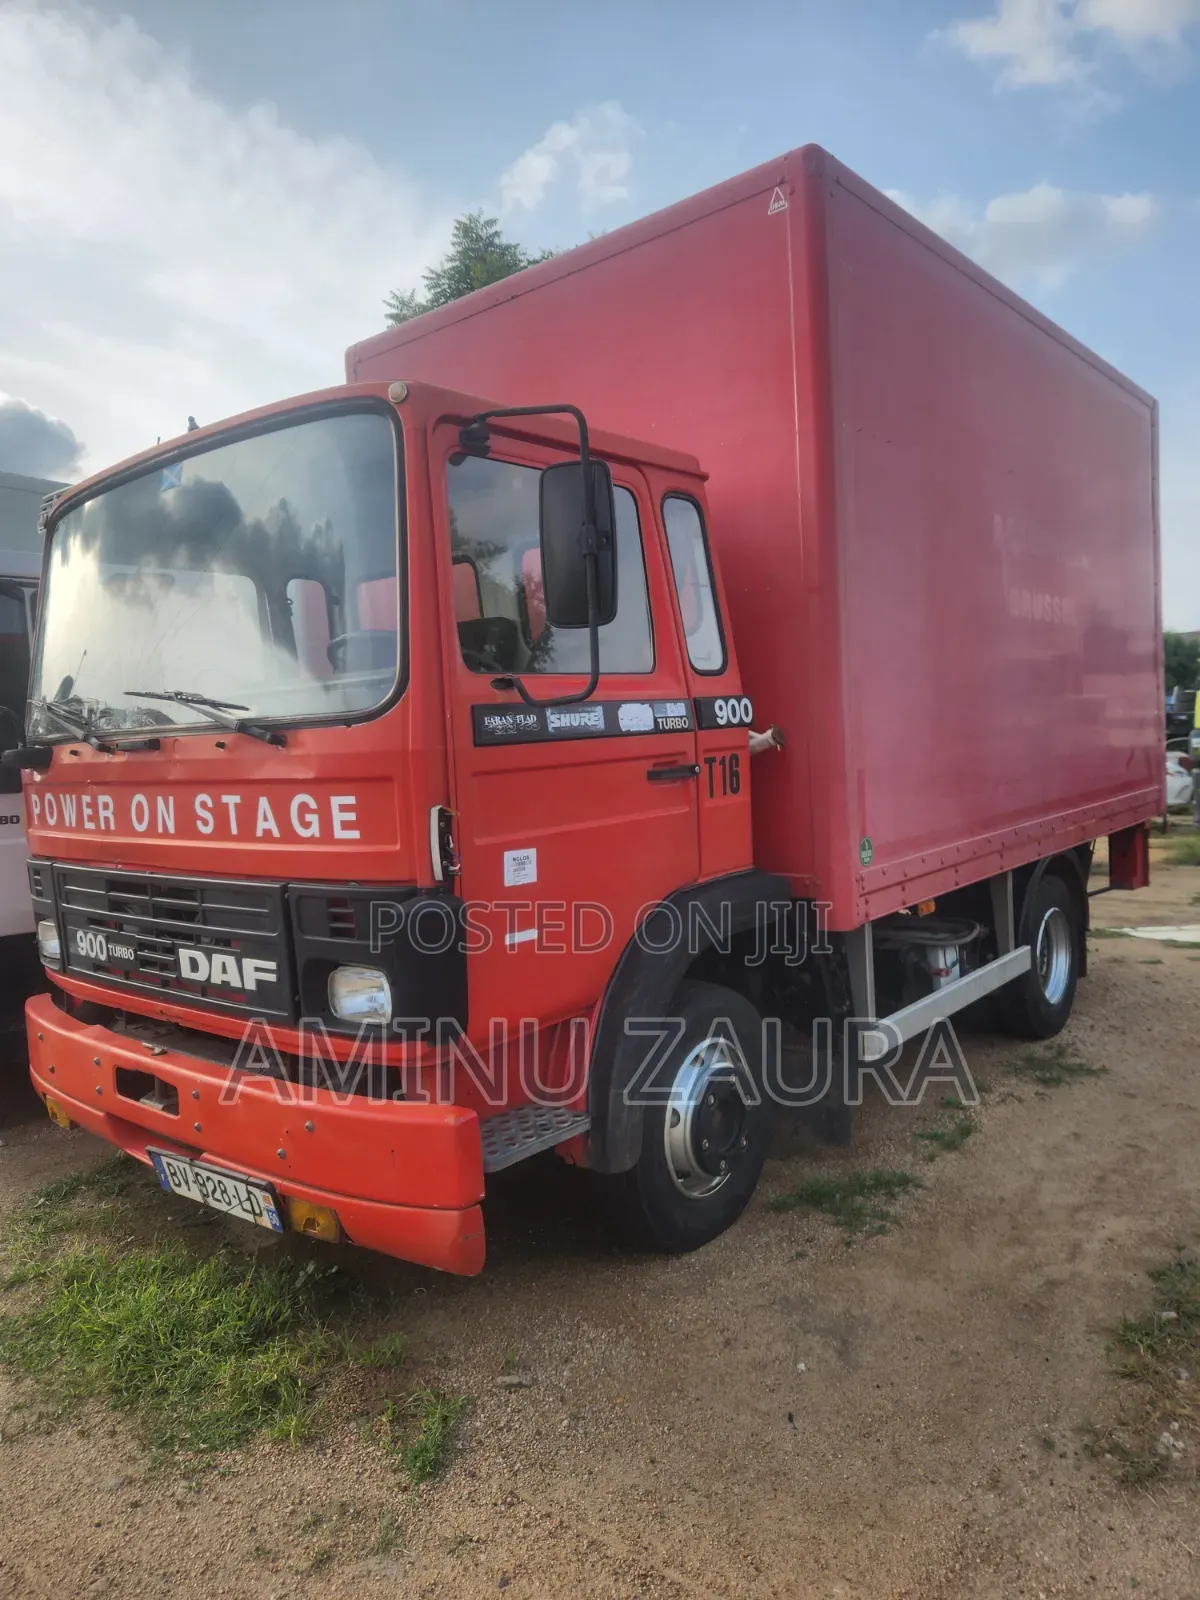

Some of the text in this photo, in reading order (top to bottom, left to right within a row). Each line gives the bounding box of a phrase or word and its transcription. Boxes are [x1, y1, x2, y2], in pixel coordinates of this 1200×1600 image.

[549, 712, 599, 728] SHURE
[657, 717, 688, 729] TURBO
[714, 698, 753, 725] 900
[704, 753, 739, 798] T16
[31, 793, 361, 839] POWER ON STAGE
[76, 930, 135, 961] 900 TURBO
[178, 948, 278, 990] DAF
